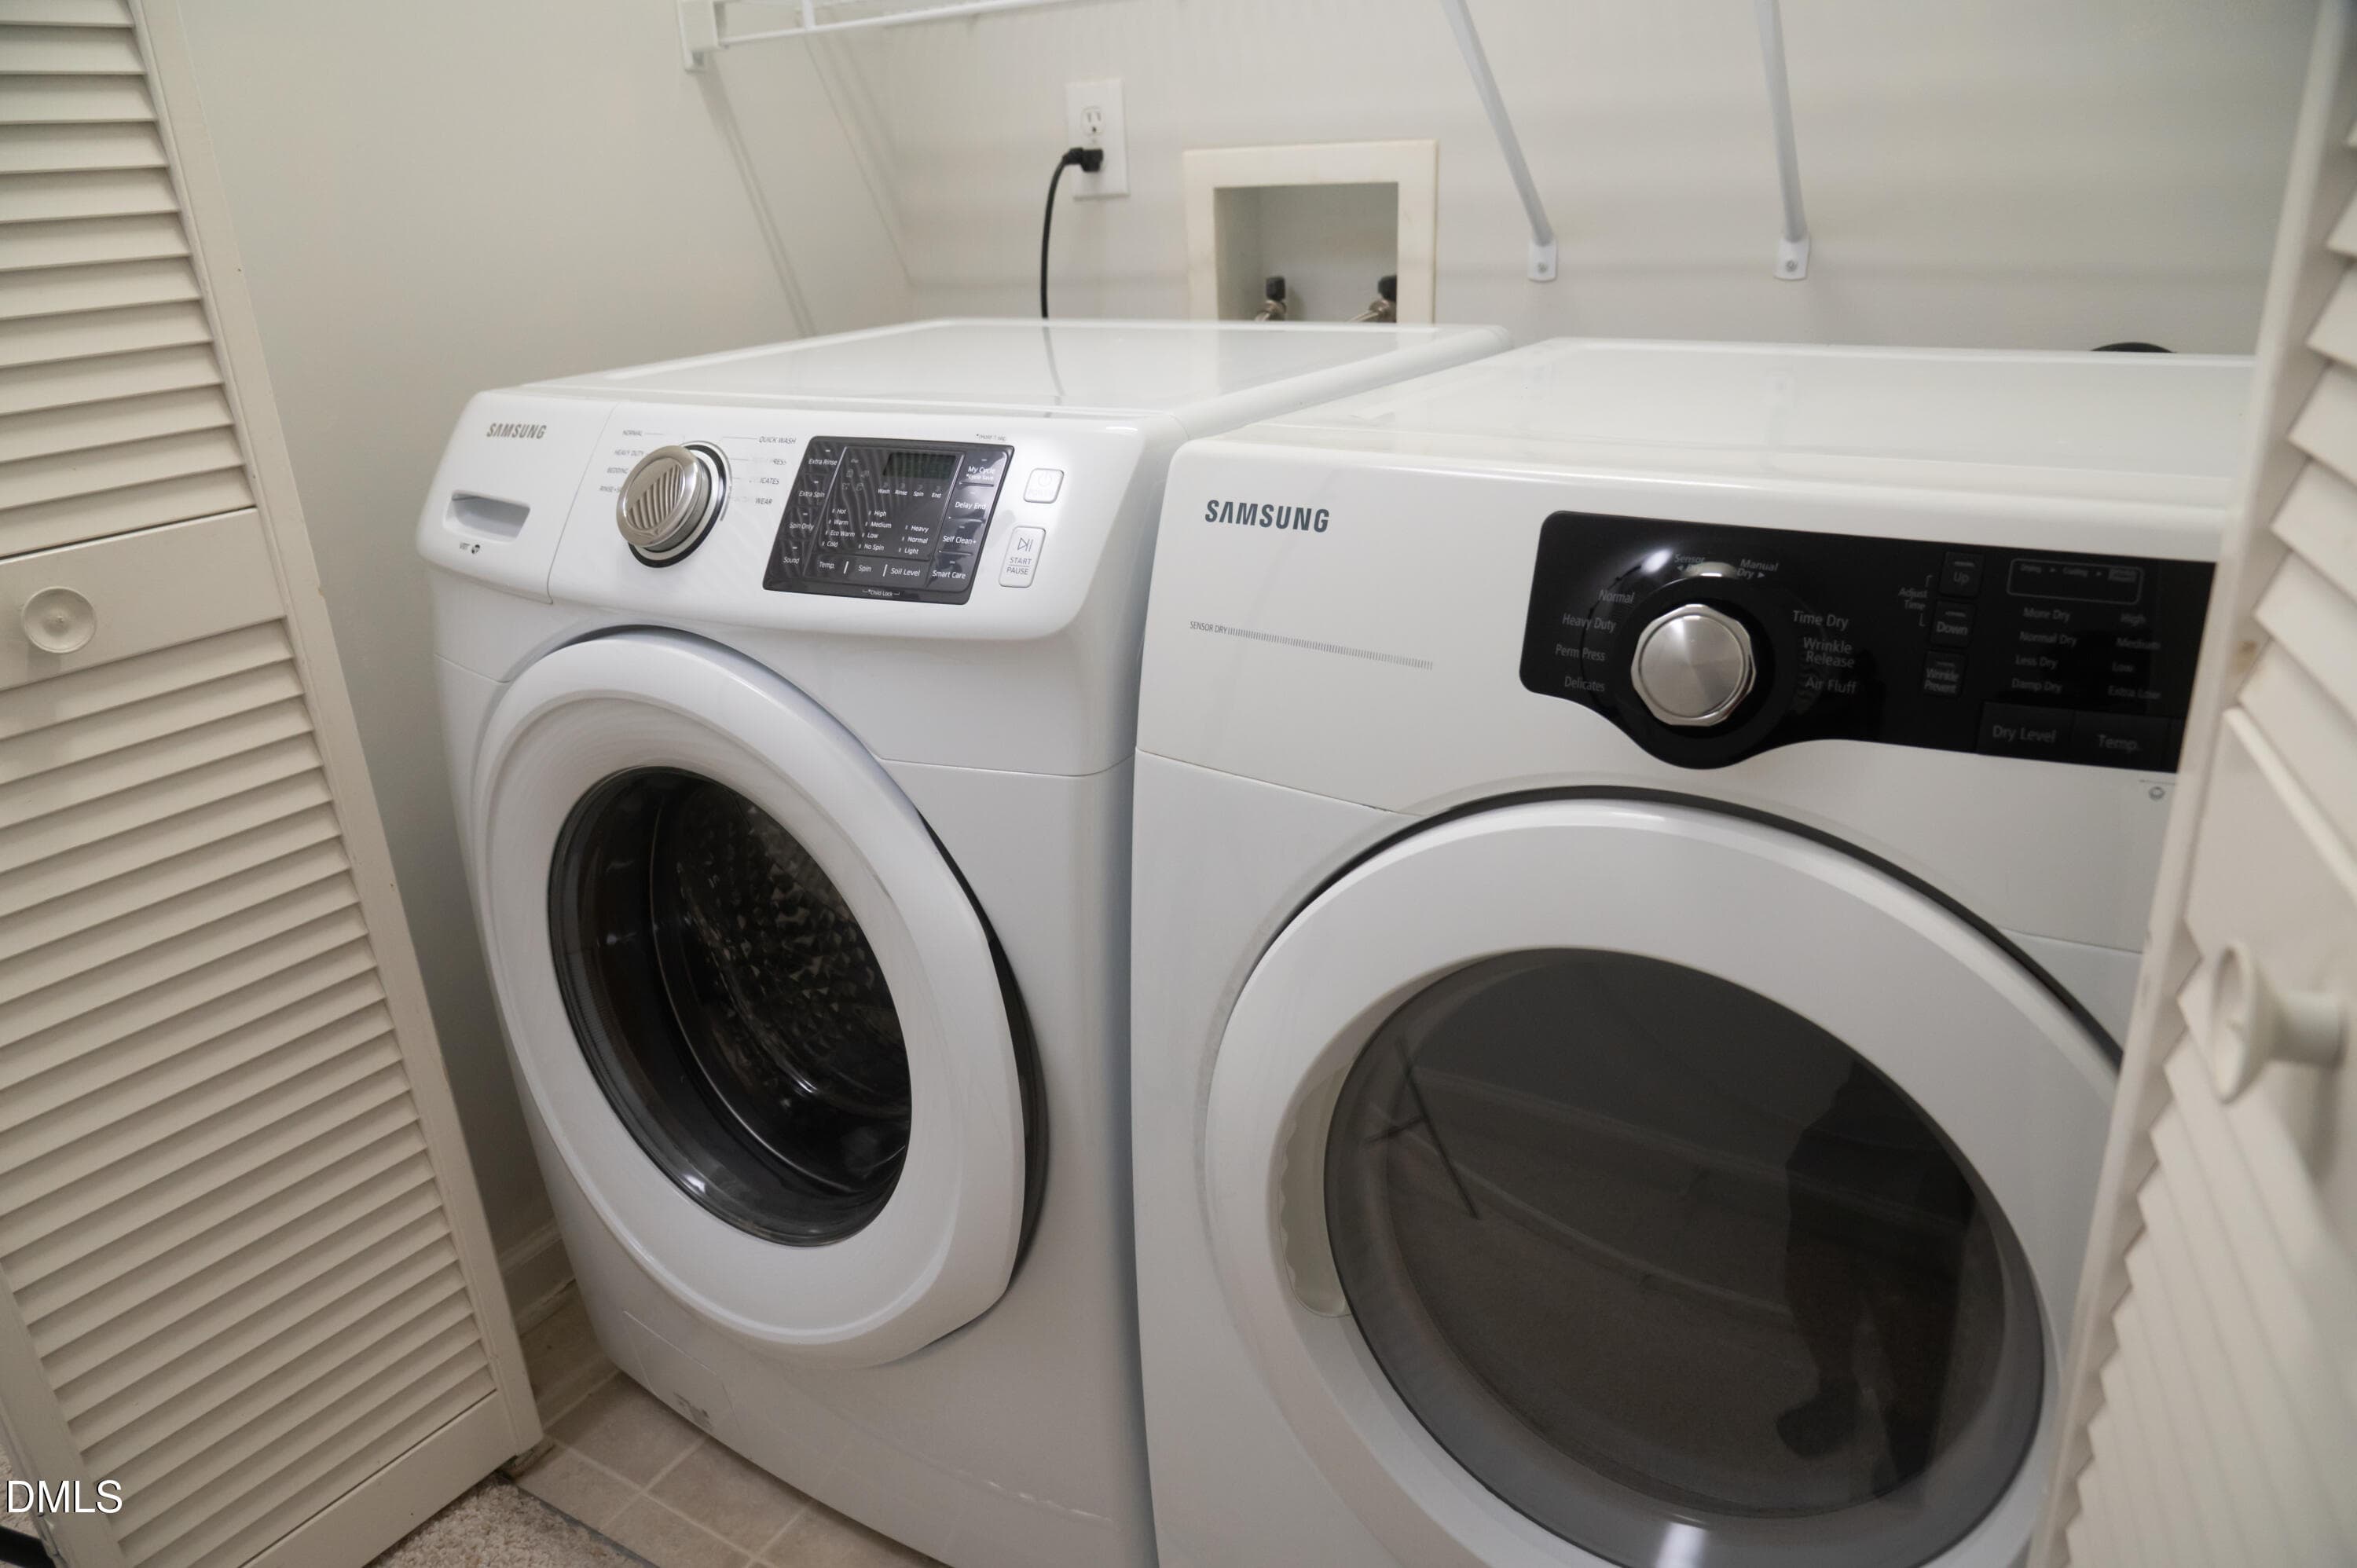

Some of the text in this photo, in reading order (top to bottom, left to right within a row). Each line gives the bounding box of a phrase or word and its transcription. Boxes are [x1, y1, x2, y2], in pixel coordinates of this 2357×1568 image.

[486, 423, 547, 439] SAMSUNG
[1204, 500, 1330, 533] SAMSUNG
[819, 561, 835, 570] Temp.
[1674, 555, 1705, 564] Sensor
[1739, 559, 1779, 572] Manual
[1006, 566, 1029, 576] PAUSE
[1736, 568, 1754, 580] Dry
[1953, 572, 1970, 585] Up
[1599, 590, 1635, 604] Normal
[1898, 587, 1928, 601] Adjust
[1904, 599, 1926, 611] Time
[1562, 613, 1617, 633] Heavy Duty
[1793, 610, 1849, 632] Time Dry
[2022, 607, 2071, 624] More Dry
[2120, 613, 2146, 627] High
[1189, 621, 1228, 635] SENSOR DRY
[1936, 621, 1968, 636] Down
[1803, 636, 1853, 654] Wrinkle
[2018, 631, 2077, 648] Normal Dry
[2116, 638, 2161, 650] Medium
[1555, 643, 1606, 661] Perm Press
[1805, 650, 1855, 669] Release
[2015, 655, 2058, 670] Less Dry
[2112, 661, 2134, 672] Low
[1564, 676, 1606, 692] Delicates
[1805, 676, 1857, 694] Air Fluff
[2011, 678, 2063, 694] Damp Dry
[2107, 685, 2161, 700] Extra Low
[1992, 724, 2057, 744] Dry Level
